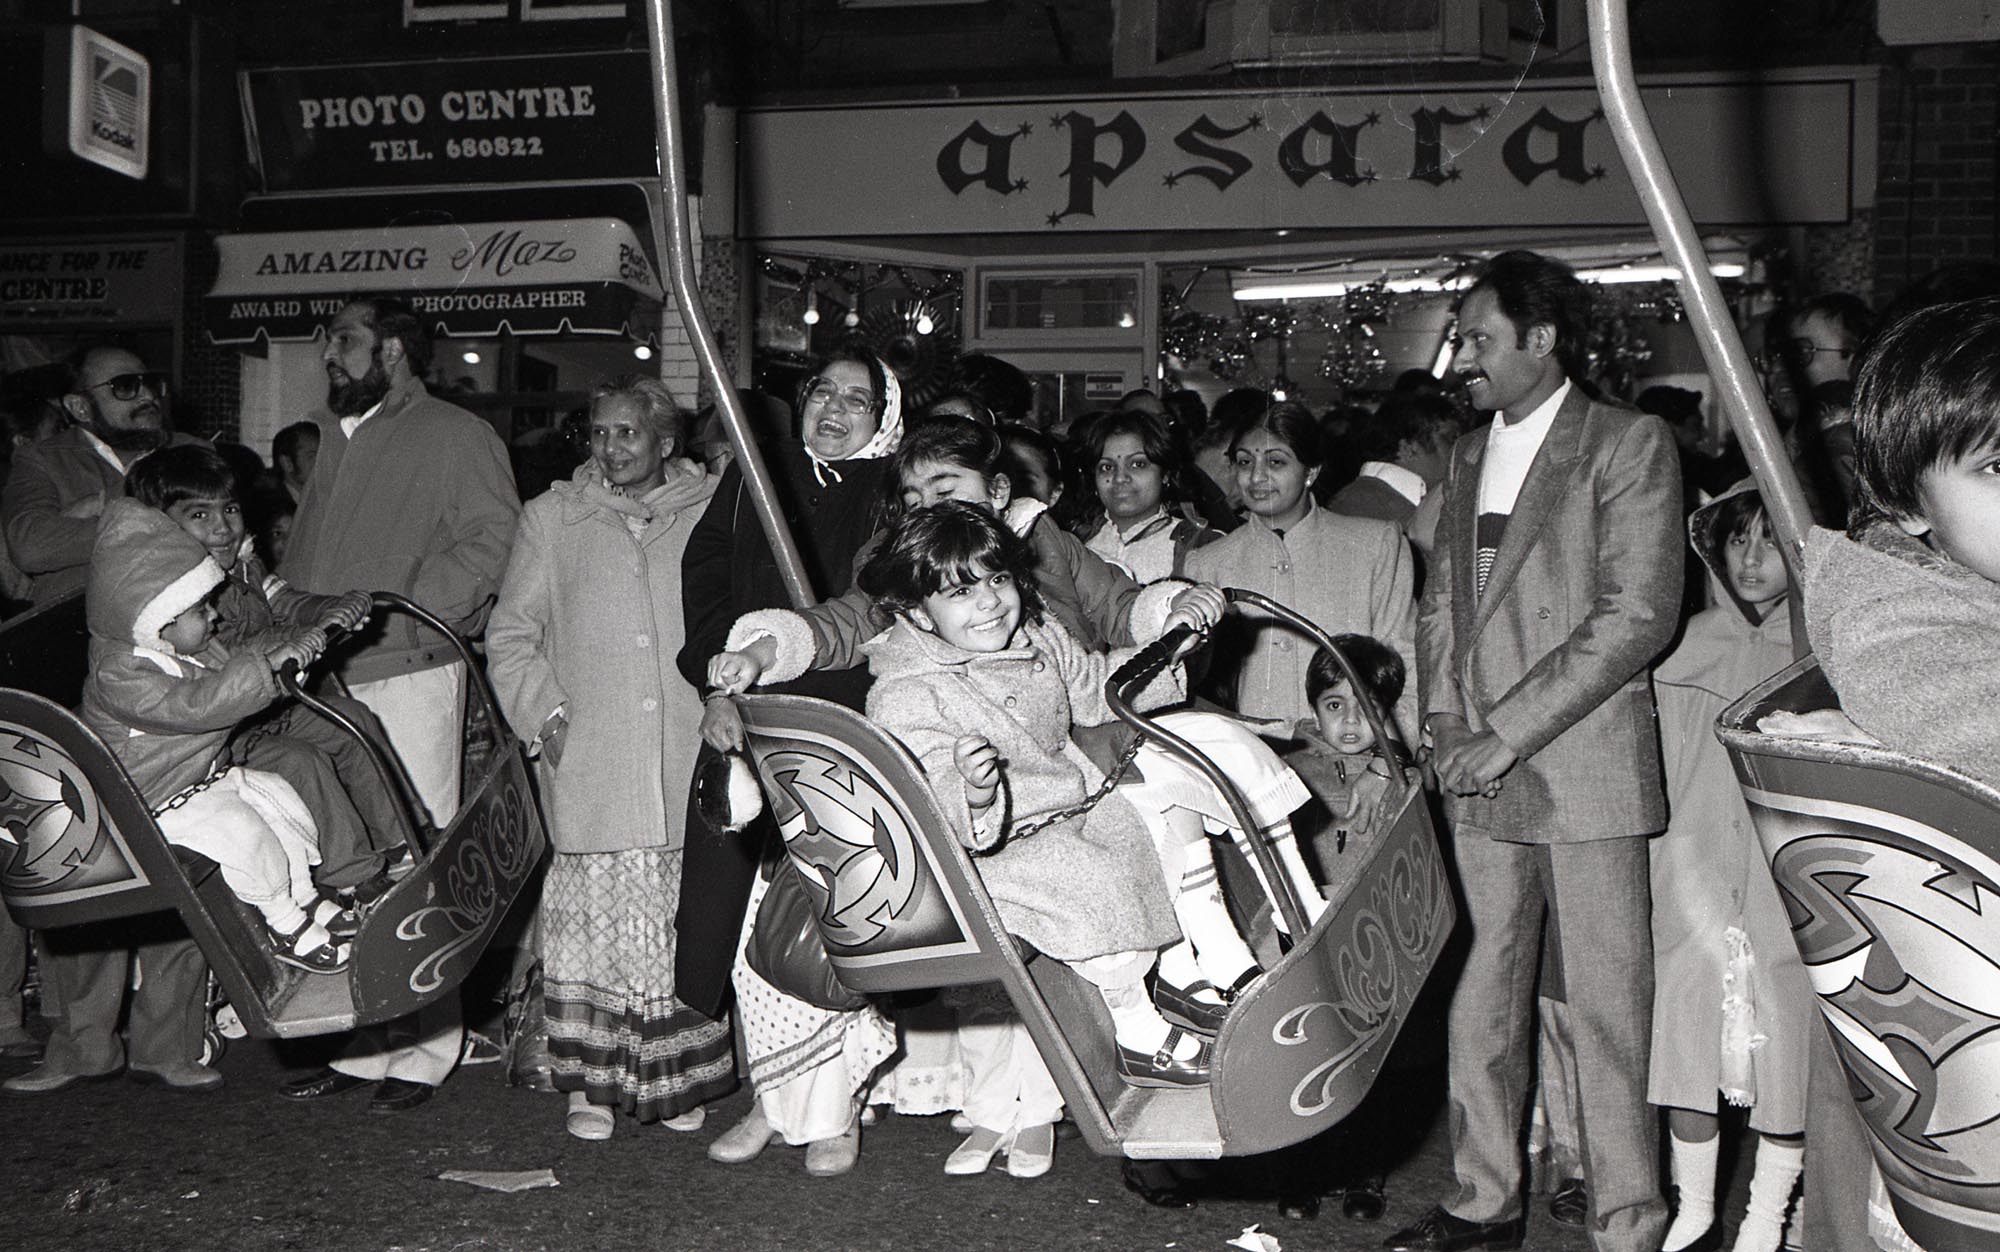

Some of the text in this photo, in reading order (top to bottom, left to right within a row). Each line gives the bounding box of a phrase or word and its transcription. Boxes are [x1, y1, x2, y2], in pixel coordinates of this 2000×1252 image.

[301, 86, 596, 130] PHOTO CENTRE
[91, 121, 136, 152] Kodak
[370, 136, 543, 163] TEL. 680822
[936, 108, 1605, 226] apsara
[60, 252, 100, 272] FOR
[107, 250, 148, 270] THE
[256, 229, 577, 277] AMAZING Maz
[0, 278, 107, 302] CENTRE
[230, 300, 301, 319] AWARD
[412, 290, 587, 313] PHOTOGRAPHER
